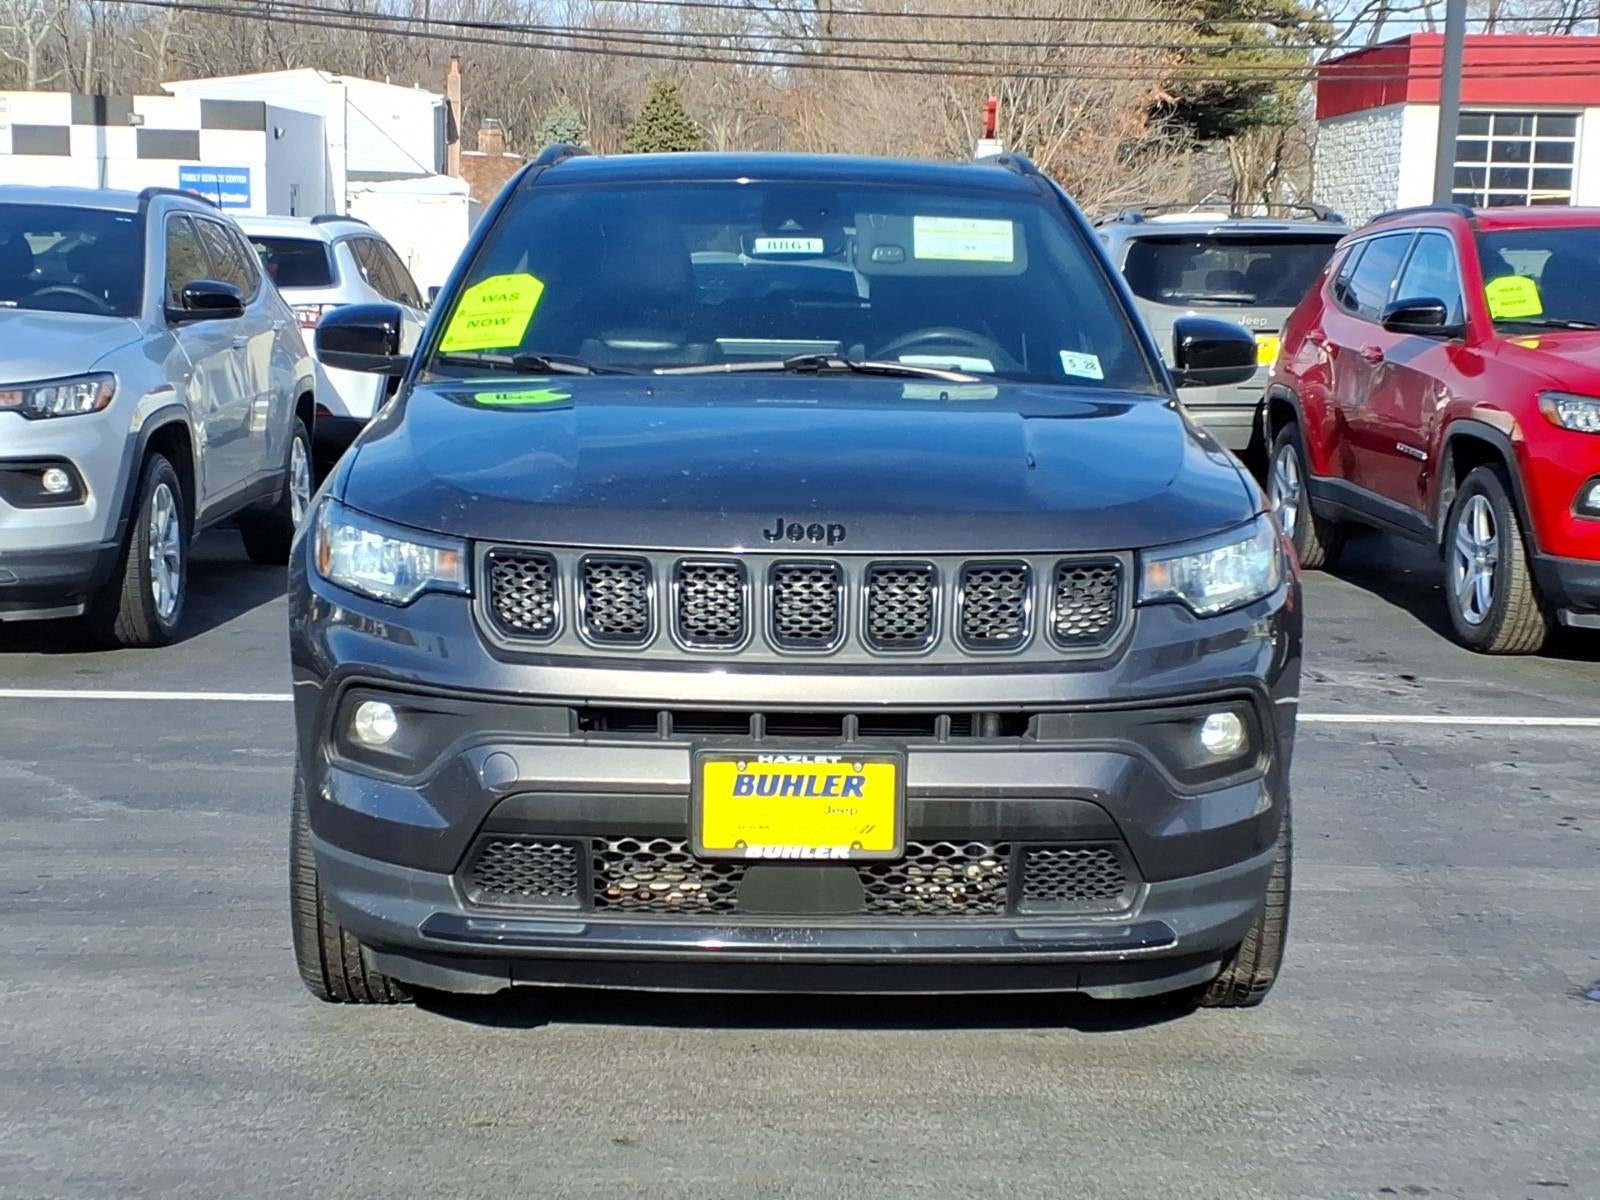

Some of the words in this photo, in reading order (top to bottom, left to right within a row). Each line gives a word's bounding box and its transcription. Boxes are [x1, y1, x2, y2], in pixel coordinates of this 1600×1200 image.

[225, 175, 247, 184] CENTER
[482, 292, 521, 303] WAS
[466, 317, 511, 329] NOW
[1238, 315, 1268, 327] Jeep
[763, 518, 846, 546] Jeep
[758, 755, 842, 764] HAZLET
[733, 774, 866, 797] BUHLER
[745, 845, 851, 859] BUHLER
